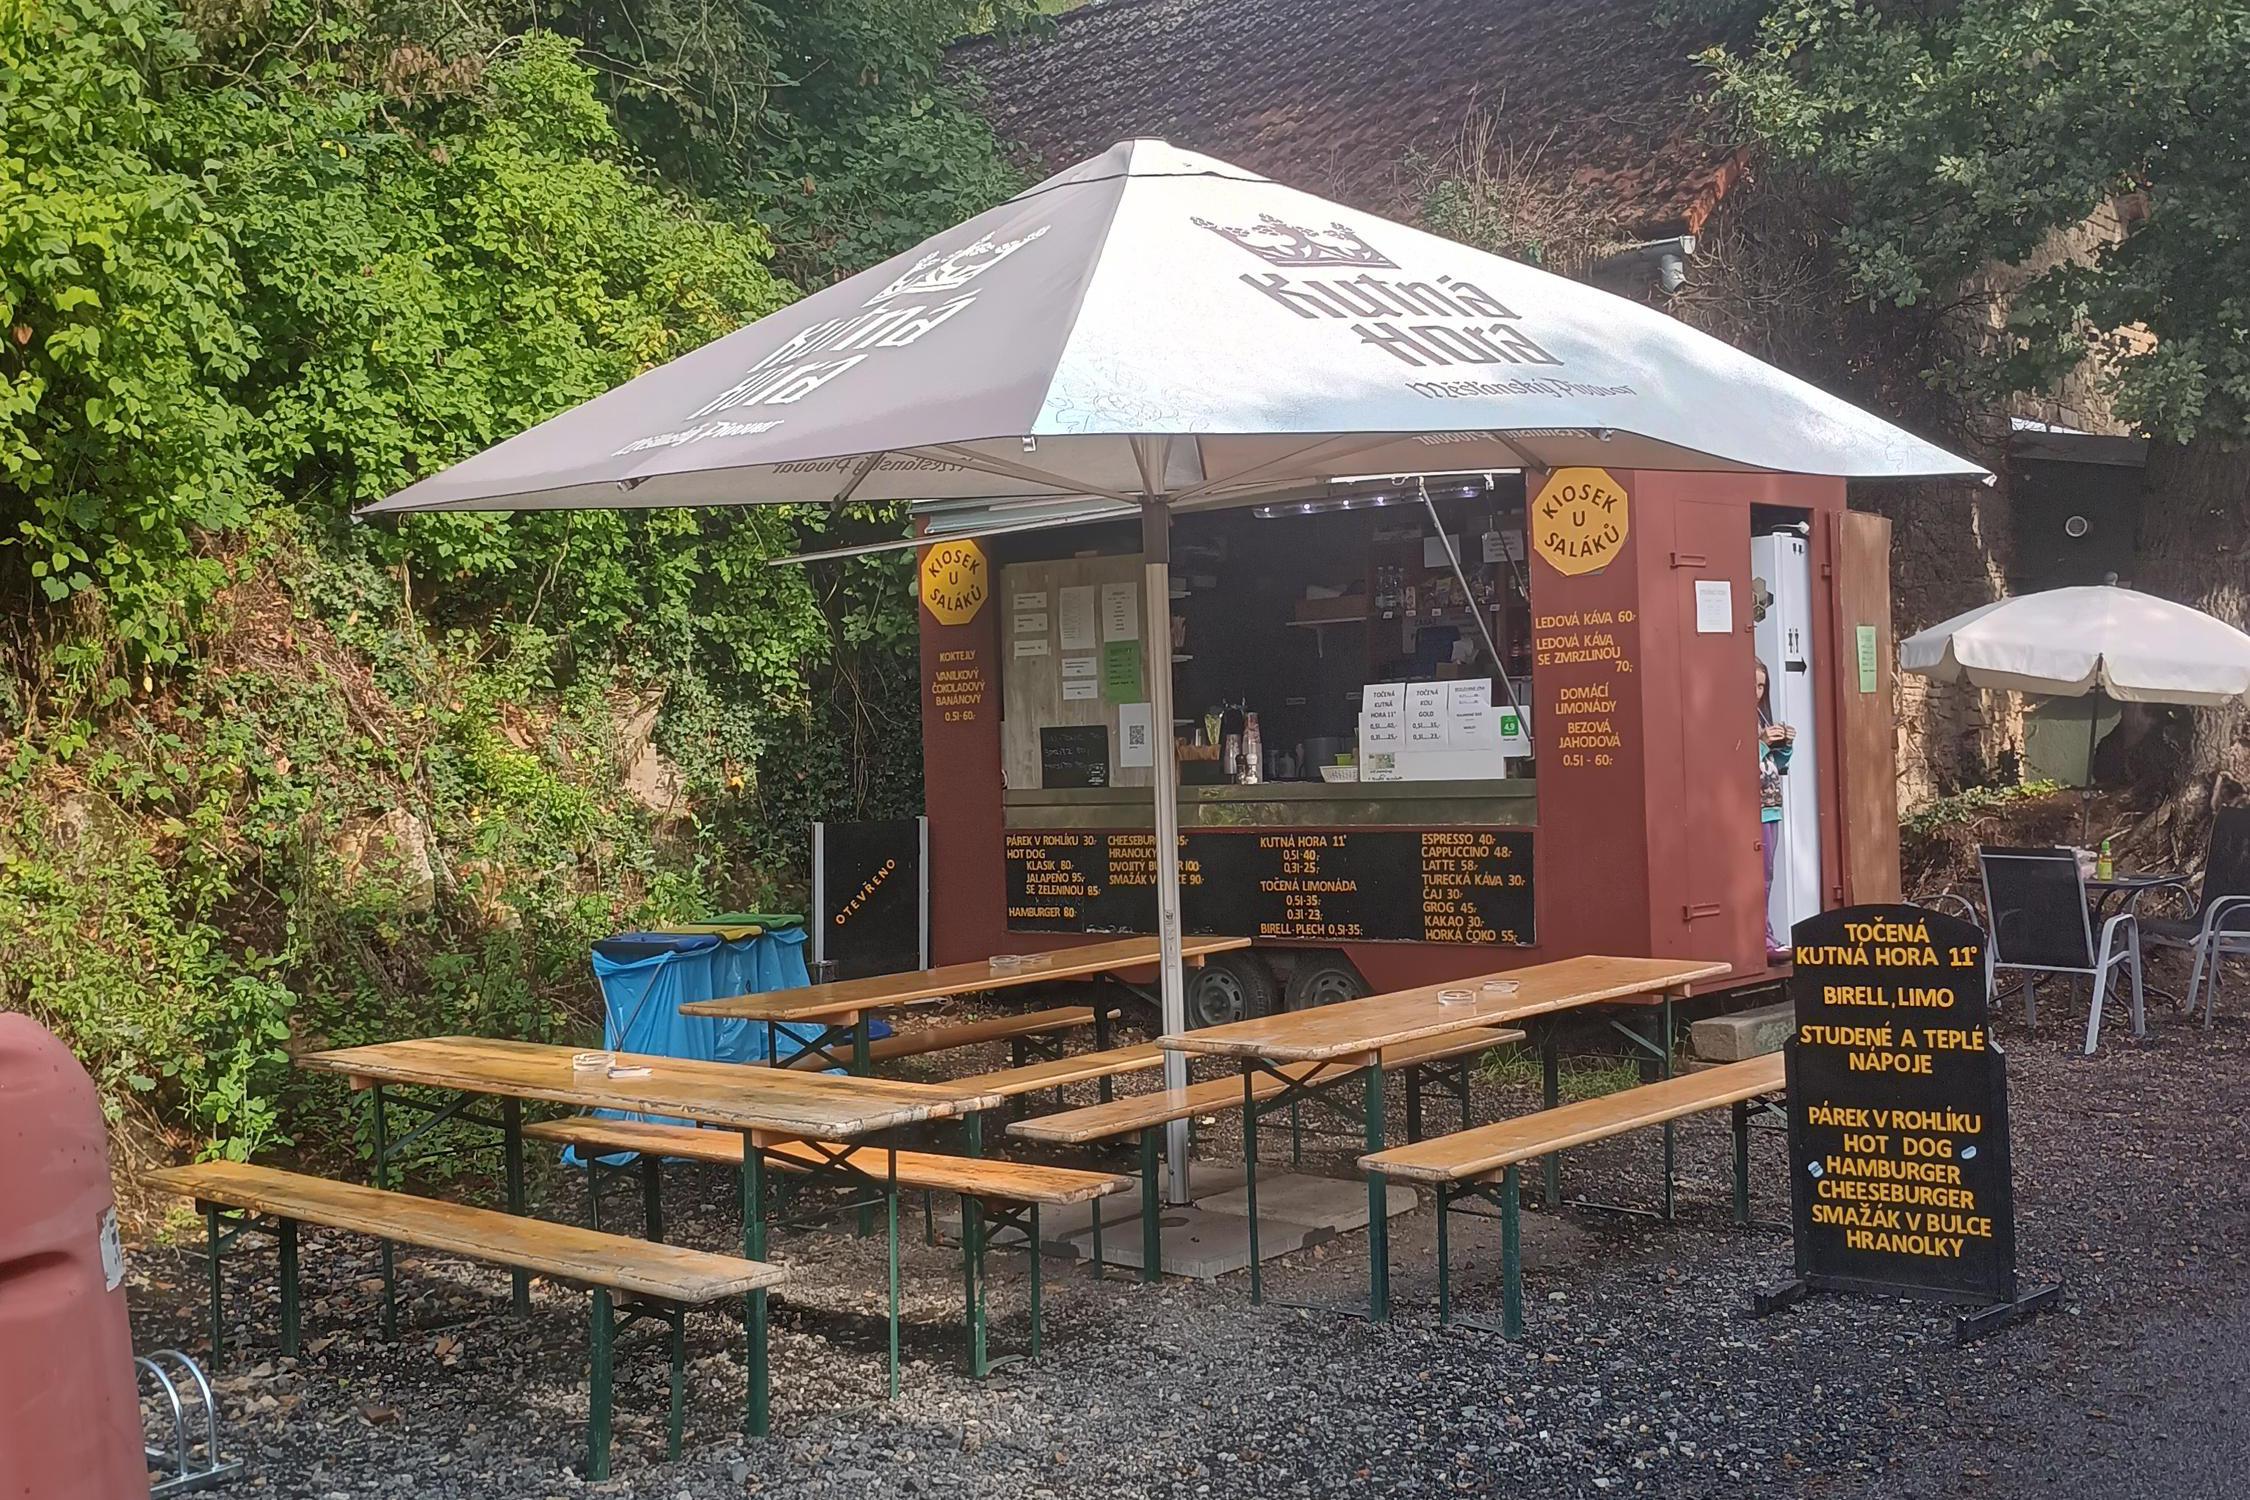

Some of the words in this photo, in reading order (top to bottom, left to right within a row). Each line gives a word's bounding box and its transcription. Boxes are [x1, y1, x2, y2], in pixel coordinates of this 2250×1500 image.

[1239, 273, 1522, 319] Kutná
[1350, 322, 1564, 366] Hora
[1542, 484, 1618, 520] KIOSEK
[1572, 510, 1586, 527] U
[1544, 523, 1620, 558] SALÁKŮ
[929, 550, 980, 578] KIOSEK
[949, 571, 958, 585] U
[930, 584, 981, 611] SALÁKŮ
[1535, 611, 1580, 629] LEDOVÁ
[1583, 609, 1613, 625] KÁVA
[1536, 633, 1580, 650] LEDOVÁ
[1584, 631, 1614, 647] KÁVA
[1537, 653, 1551, 665] SE
[1554, 646, 1621, 664] ZMRZLINOU
[1373, 690, 1396, 698] TOČENÁ
[1416, 688, 1439, 697] TOČENÁ
[1560, 681, 1609, 700] DOMÁCÍ
[935, 692, 982, 706] BANÁNOVÝ
[1555, 699, 1617, 715] LIMONÁDY
[1567, 718, 1612, 734] BEZOVÁ
[1558, 732, 1621, 749] JAHODOVÁ
[1006, 834, 1032, 846] PÁREK
[1034, 836, 1041, 846] V
[1043, 833, 1079, 846] ROHLÍKU
[1260, 834, 1295, 848] KUTNÁ
[1298, 836, 1328, 847] HORA
[1421, 833, 1473, 845] ESPRESSO
[1007, 849, 1024, 859] HOT
[1026, 849, 1046, 859] DOG
[1109, 848, 1157, 858] HRANOLKY
[1421, 846, 1489, 857] CAPPUCCINO
[1026, 860, 1055, 871] KLASIK
[1422, 860, 1455, 871] LATTE
[1109, 872, 1147, 885] SMAŽÁK
[1149, 875, 1157, 885] V
[1260, 877, 1300, 892] TOČENÁ
[1302, 877, 1357, 892] LIMONÁDA
[1421, 871, 1471, 885] TURECKÁ
[1474, 871, 1503, 886] KÁVA
[835, 859, 896, 925] OTEVŘENO
[1026, 884, 1036, 895] SE
[1038, 885, 1084, 895] ZELENINOU
[1422, 886, 1443, 900] ČAJ
[1009, 907, 1060, 917] HAMBURGER
[1422, 901, 1455, 913] GROG
[1424, 915, 1464, 927] KAKAO
[1425, 927, 1463, 940] HORKÁ
[1466, 926, 1496, 941] ČOKO
[1845, 917, 1930, 943] TOČENÁ
[1796, 942, 1869, 967] KUTNÁ
[1876, 947, 1939, 967] HORA
[1949, 946, 1978, 968] 11°
[1800, 1021, 1893, 1048] STUDENÉ
[1901, 1029, 1917, 1048] A
[1923, 1024, 1985, 1051] TEPLÉ
[1849, 1046, 1933, 1074] NÁPOJE
[1808, 1101, 1870, 1129] PÁREK
[1873, 1110, 1889, 1128] V
[1892, 1105, 1981, 1134] ROHLÍKU
[1844, 1133, 1889, 1154] HOT
[1903, 1138, 1952, 1159] DOG
[1826, 1155, 1961, 1185] HAMBURGER
[1817, 1180, 1974, 1210] CHEESEBURGER
[1811, 1202, 1901, 1231] SMAŽÁK
[1905, 1212, 1921, 1231] V
[1927, 1215, 1992, 1238] BULCE
[1846, 1230, 1964, 1258] HRANOLKY
